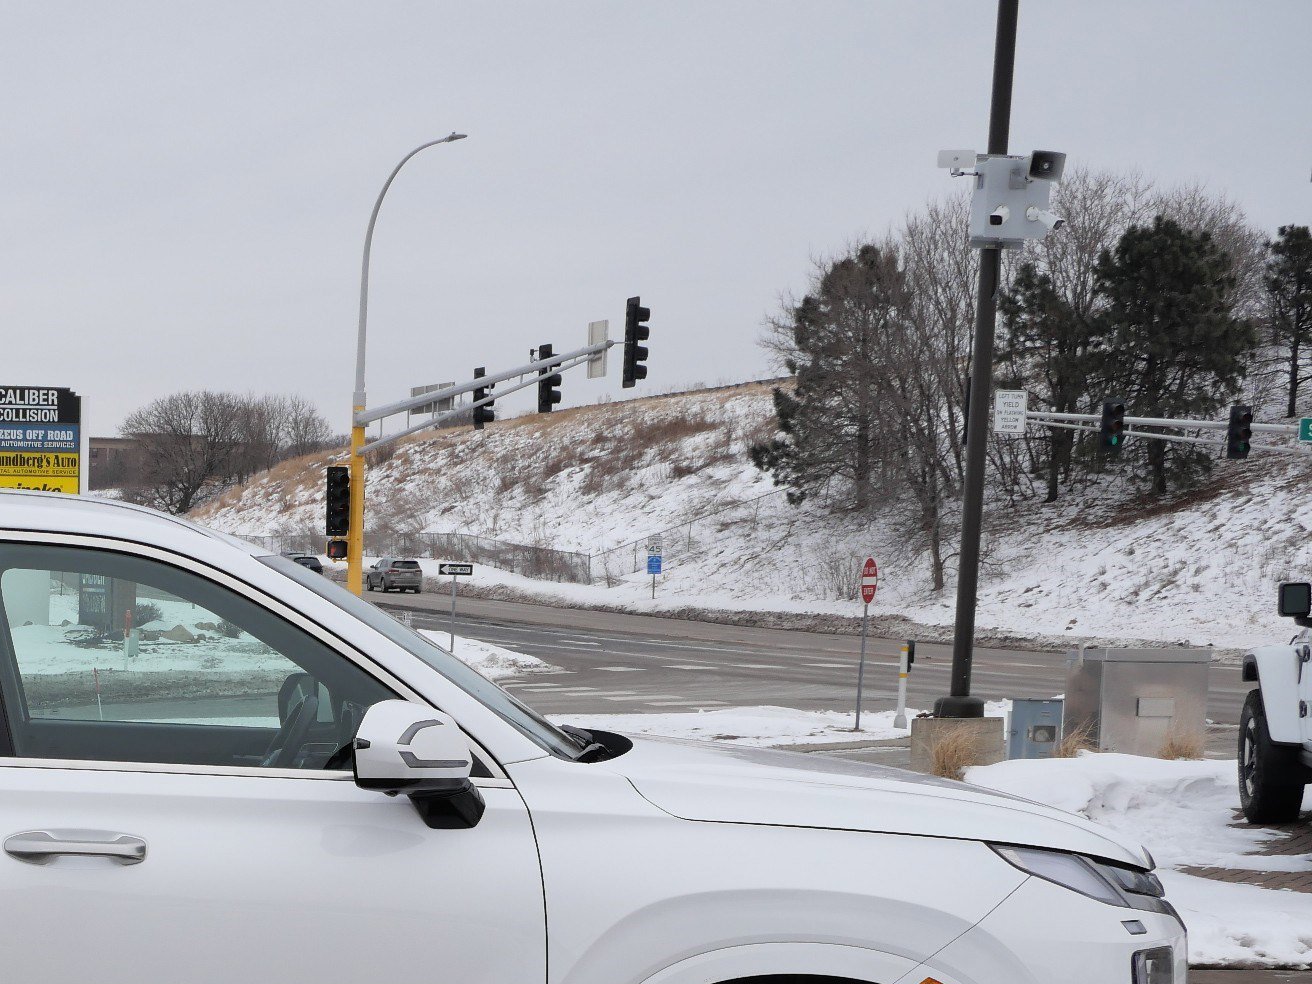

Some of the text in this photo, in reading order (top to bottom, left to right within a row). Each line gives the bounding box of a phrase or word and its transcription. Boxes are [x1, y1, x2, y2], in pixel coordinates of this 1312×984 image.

[26, 430, 44, 440] OFF
[47, 430, 74, 441] ROAD
[1, 440, 42, 448] AUTOMOTIVE
